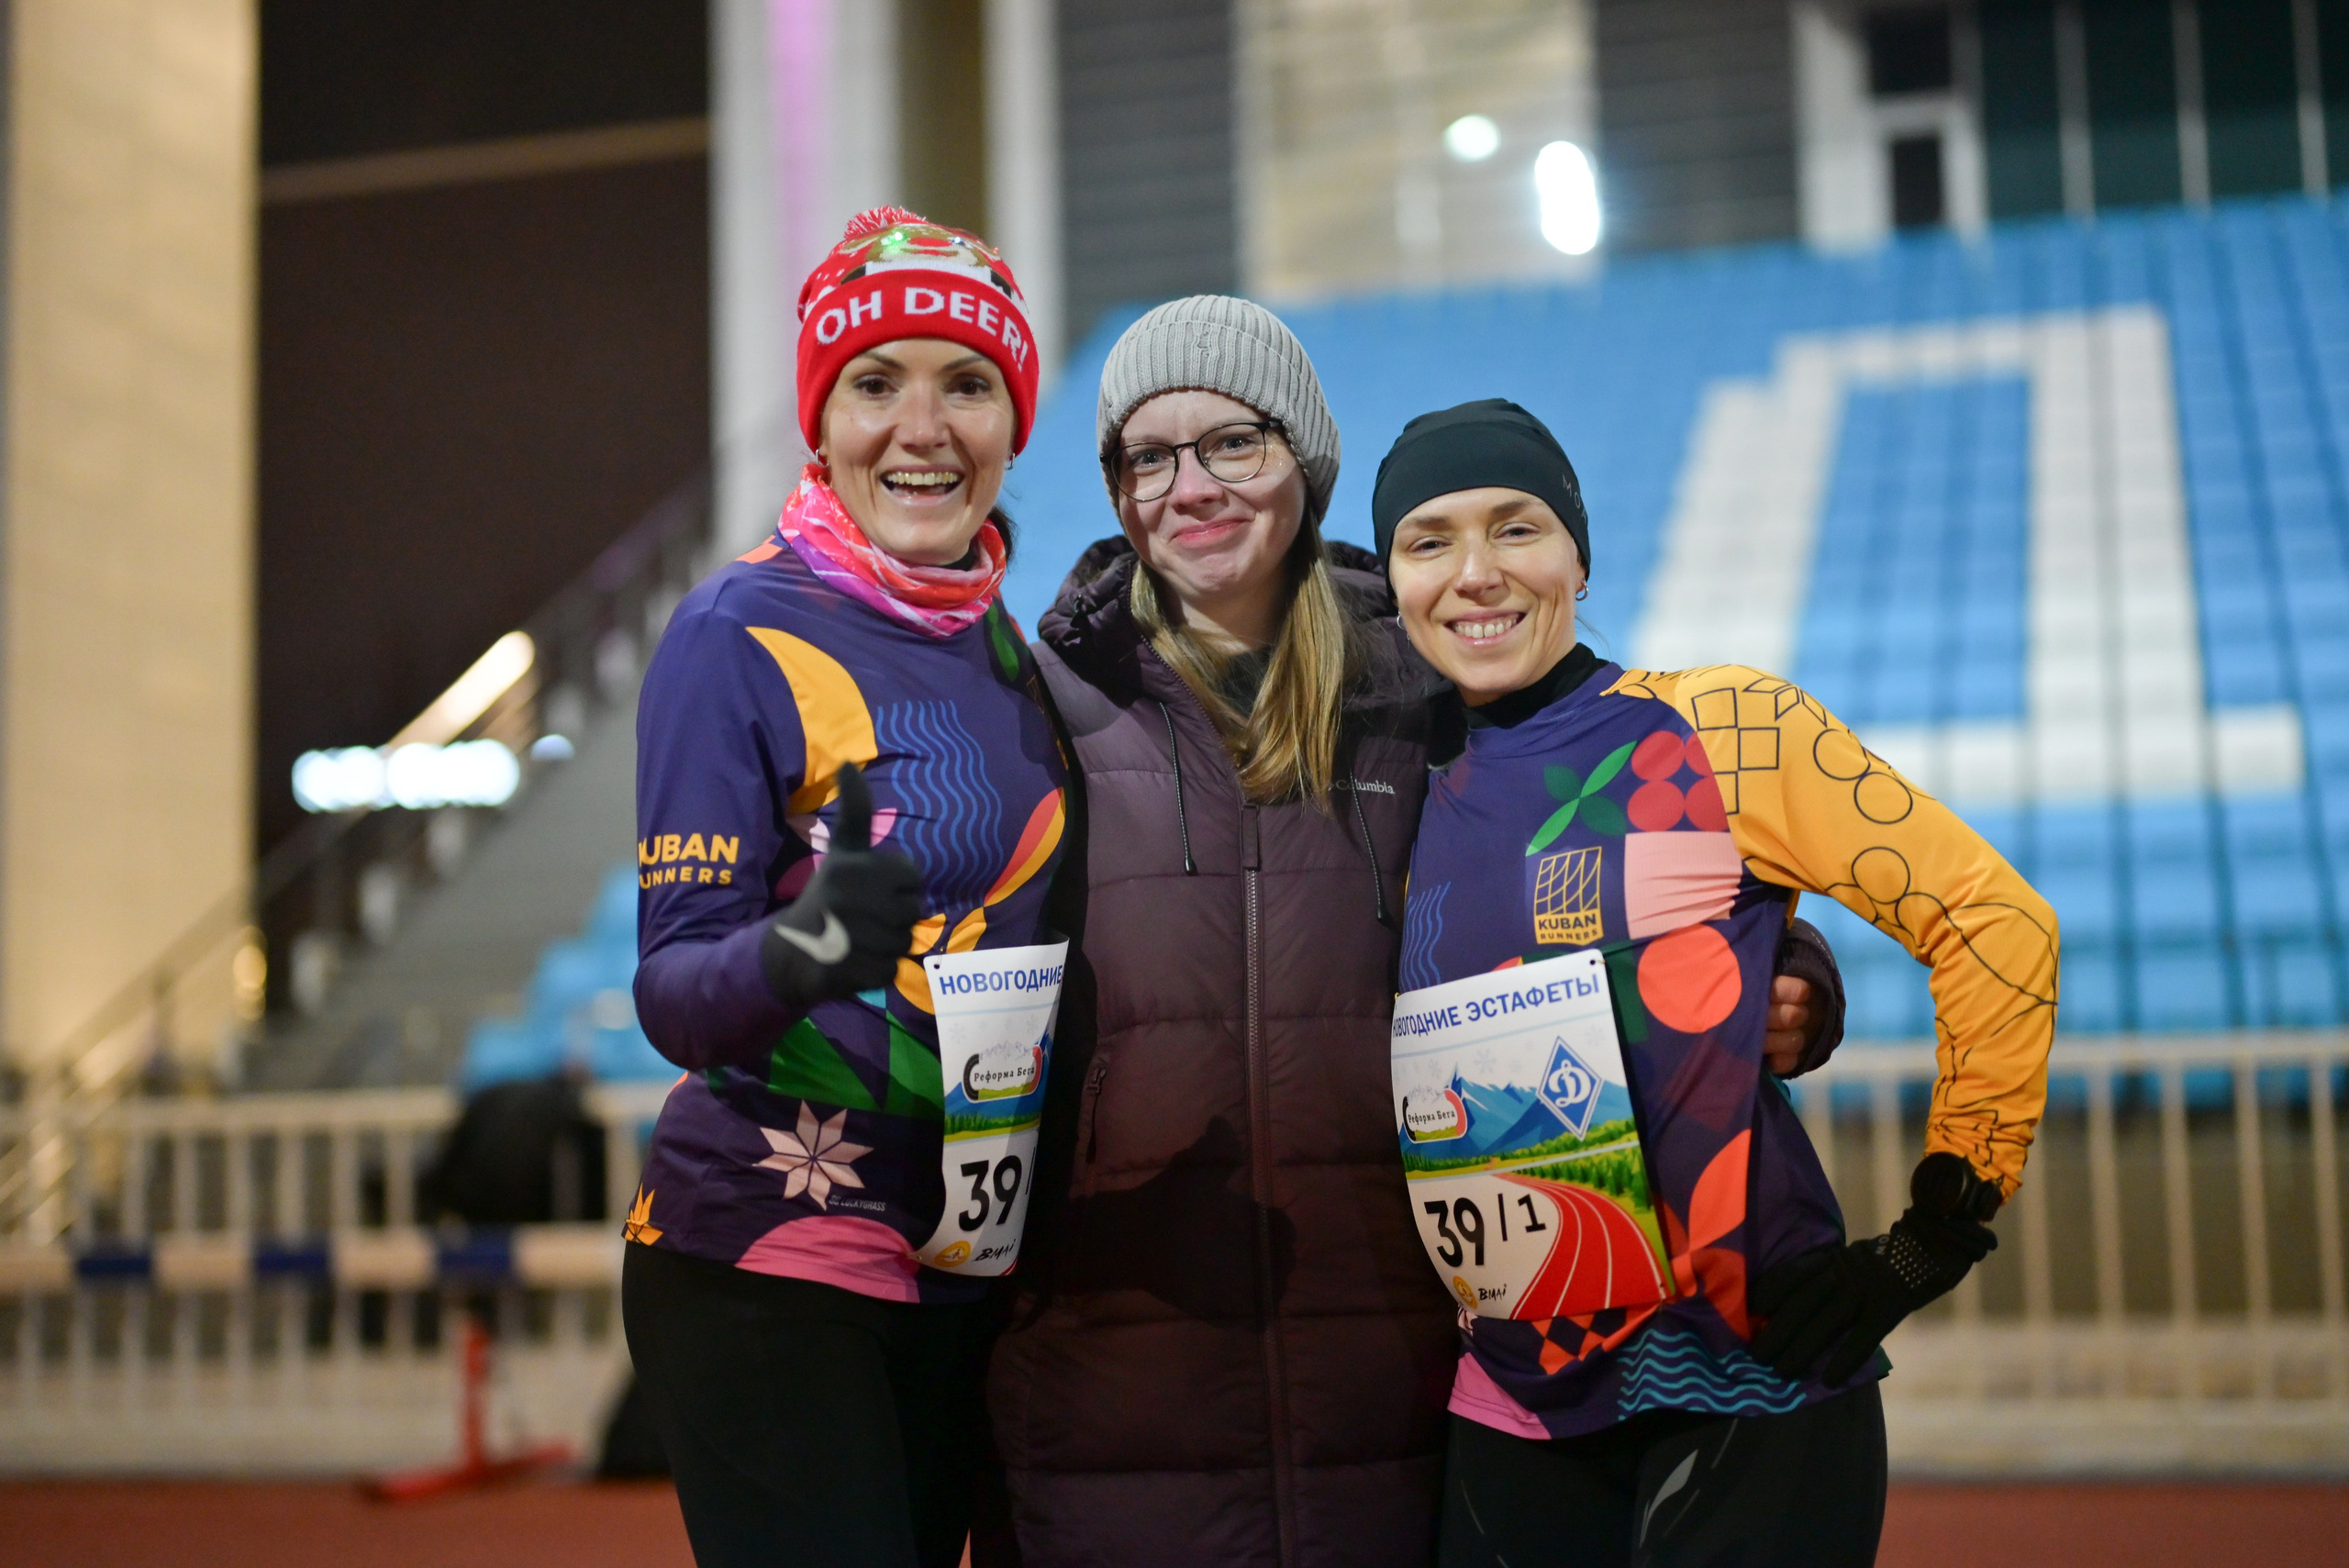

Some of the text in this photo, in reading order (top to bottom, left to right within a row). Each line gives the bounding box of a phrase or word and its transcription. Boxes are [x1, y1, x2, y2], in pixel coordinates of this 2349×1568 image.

[816, 287, 1029, 373] OH DEER!
[639, 833, 740, 866] UBAN
[1538, 914, 1597, 930] KUBAN
[1540, 929, 1598, 940] RUNNERS
[939, 964, 1063, 995] НОВОГОДНИЕ
[1466, 973, 1600, 1021] ЭСТАФЕТЫ
[974, 1066, 1035, 1084] Реформа Бега
[1408, 1110, 1456, 1124] Реформа Бега
